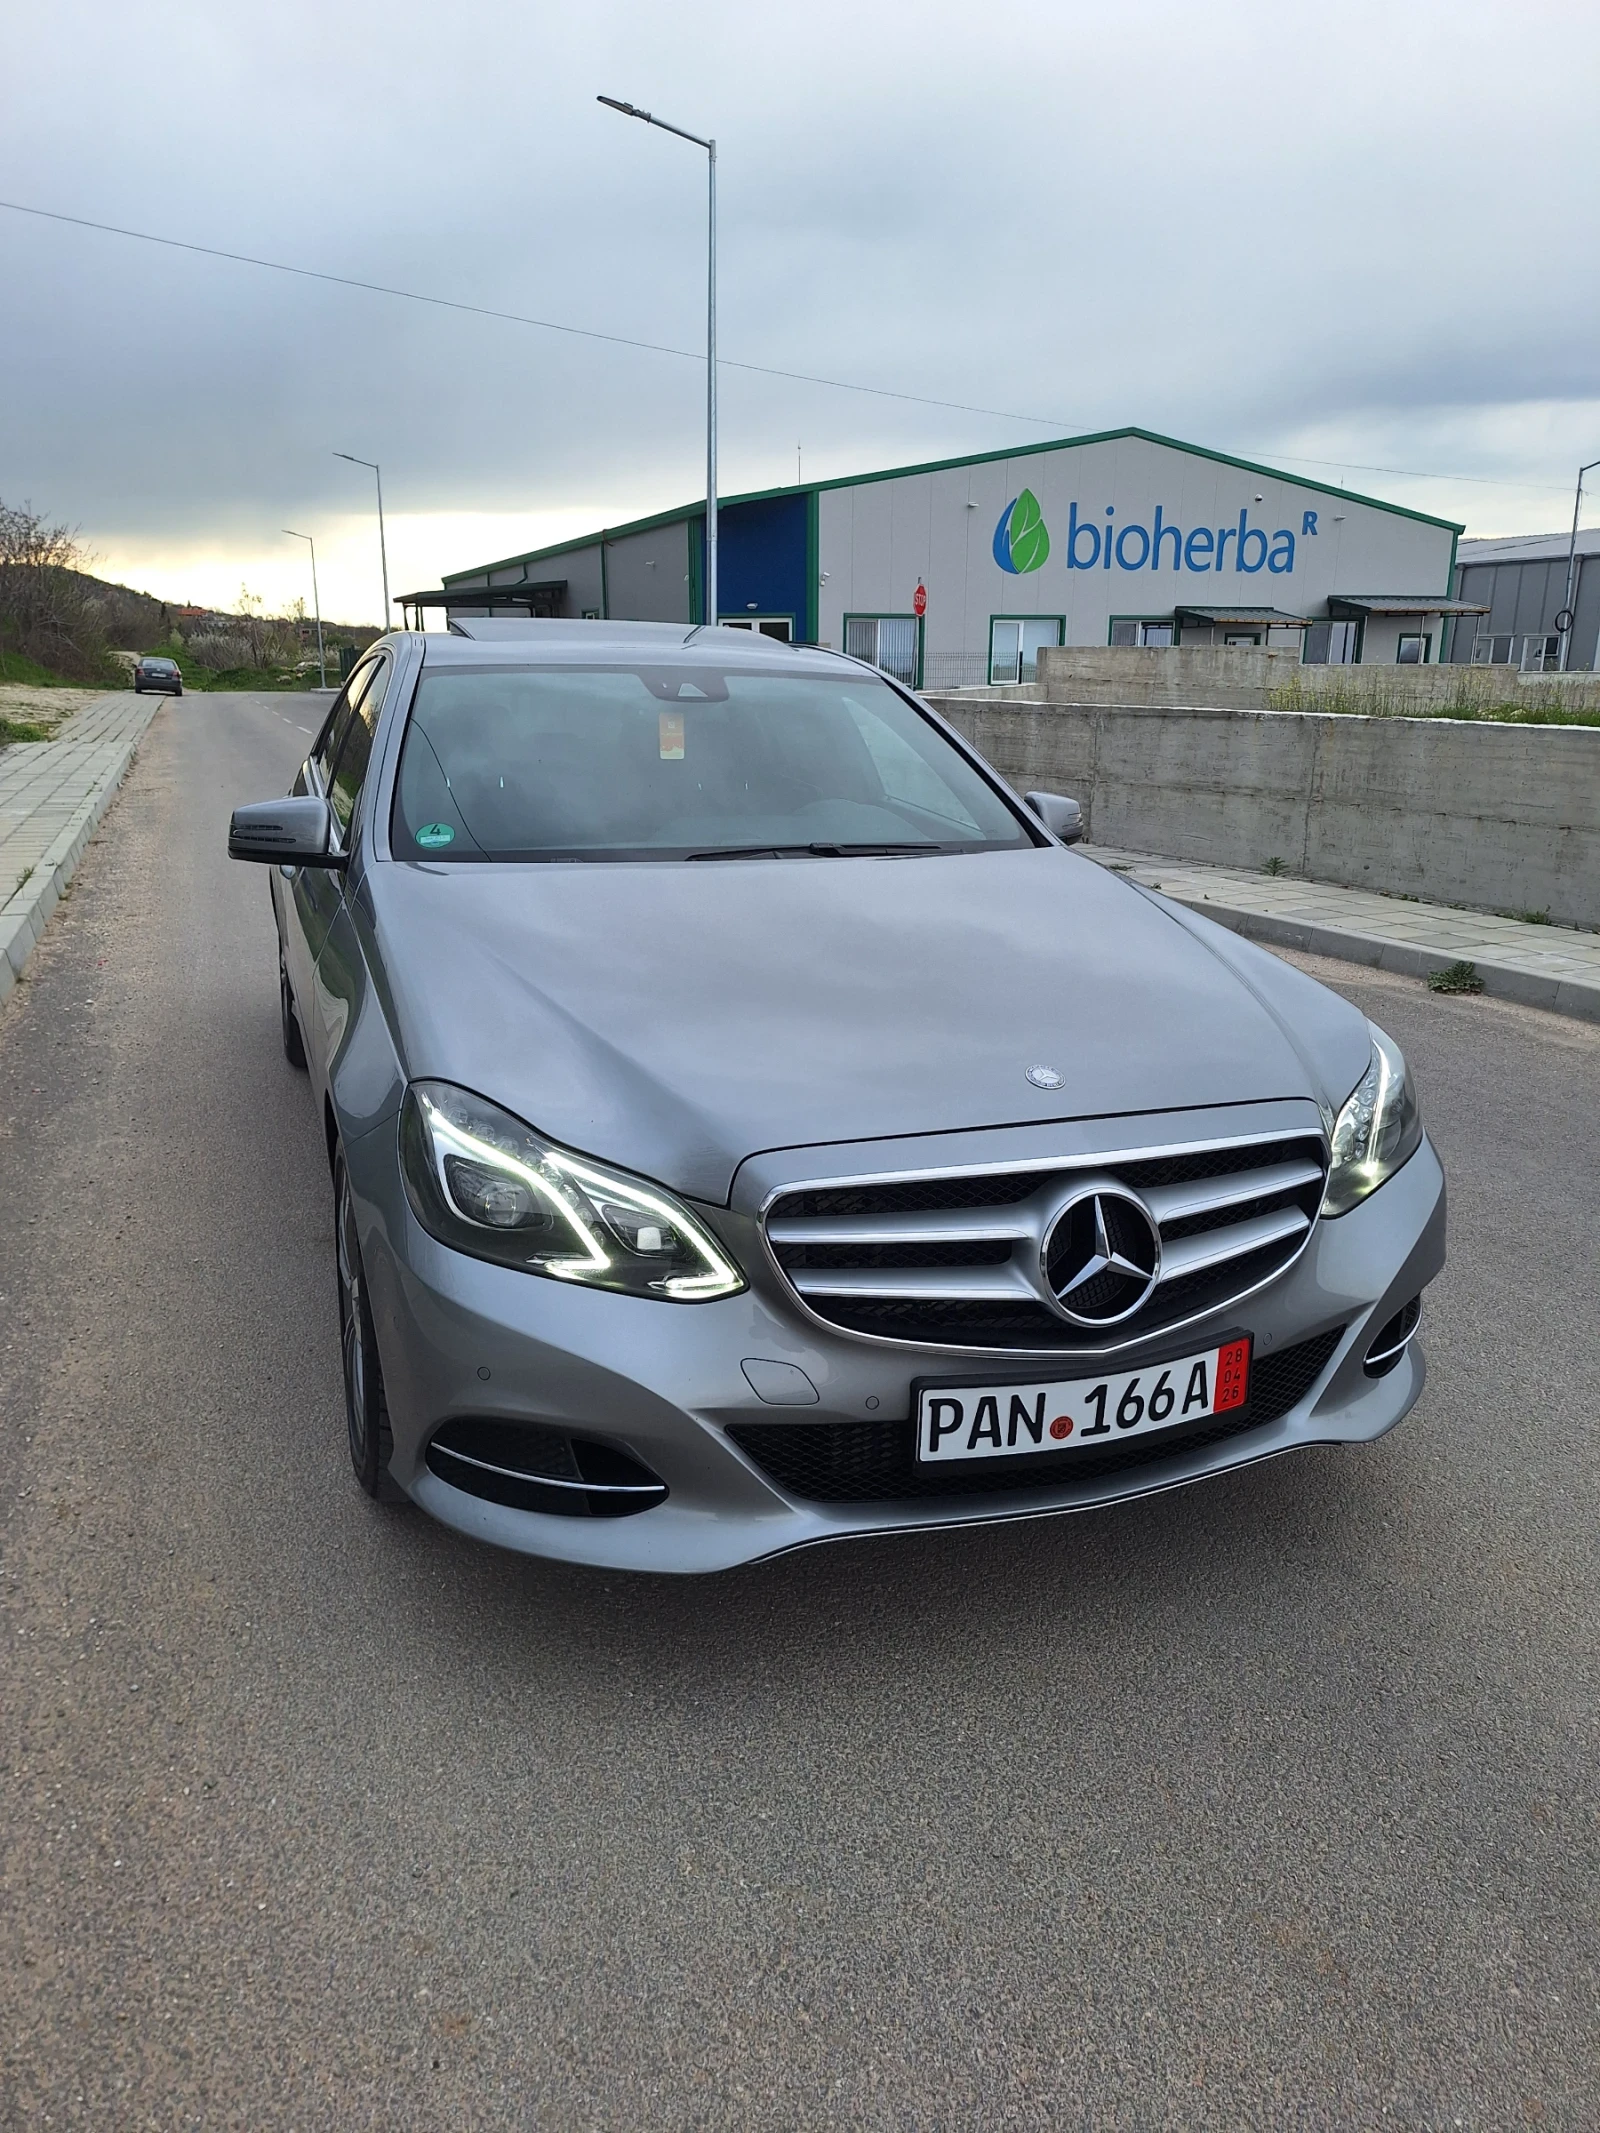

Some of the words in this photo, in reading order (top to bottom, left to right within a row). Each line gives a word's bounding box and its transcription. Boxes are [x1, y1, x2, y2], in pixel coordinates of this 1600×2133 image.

[1066, 502, 1296, 573] bioherba
[914, 593, 926, 607] STOP
[430, 824, 441, 835] 4
[1225, 1347, 1243, 1366] 28
[1224, 1367, 1241, 1384] 04
[1221, 1385, 1240, 1403] 26
[928, 1392, 1046, 1453] PAN
[1080, 1360, 1209, 1437] 166A
